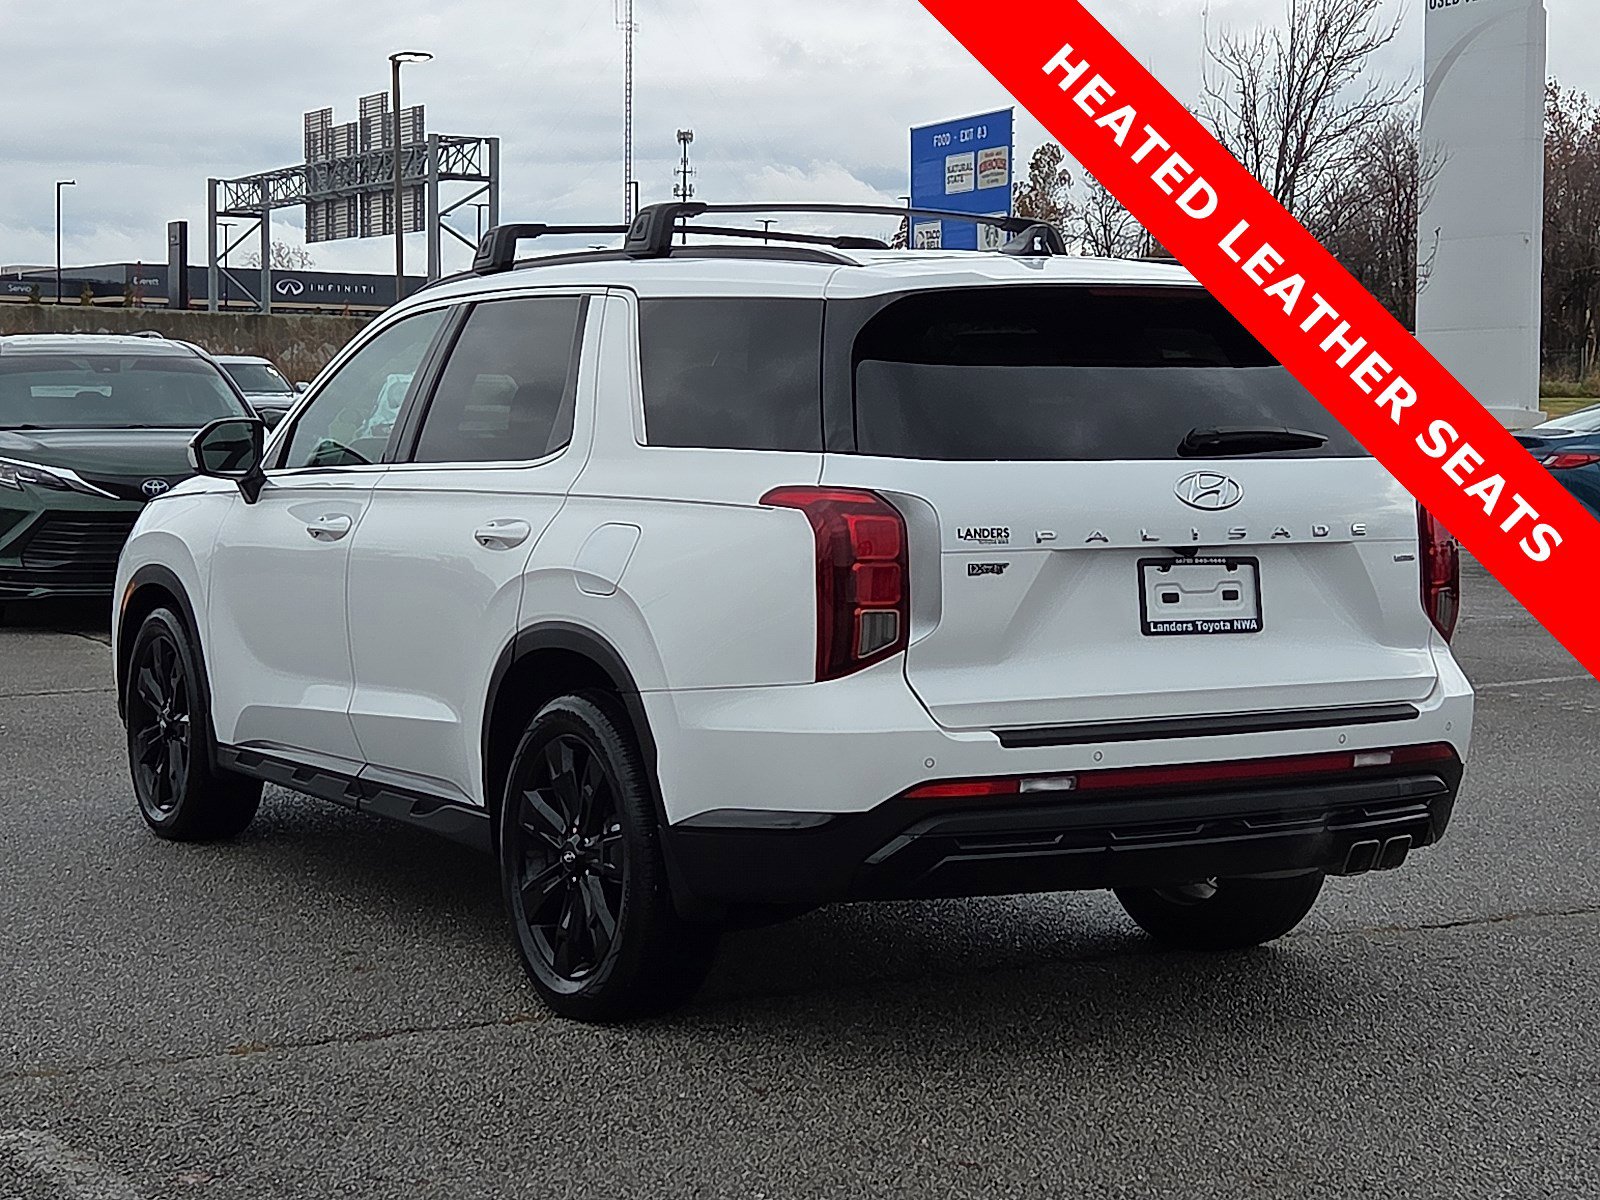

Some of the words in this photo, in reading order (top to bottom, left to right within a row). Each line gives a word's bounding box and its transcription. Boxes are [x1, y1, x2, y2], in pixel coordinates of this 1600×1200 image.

[933, 132, 951, 147] FOOD
[960, 128, 974, 143] EXIT
[946, 162, 974, 174] NATURAL
[946, 174, 965, 185] STATE
[925, 229, 941, 240] TACO
[310, 283, 375, 294] INFINITI
[957, 527, 1010, 540] LANDERS
[1035, 522, 1368, 543] PALISADE
[1150, 621, 1194, 632] Landers
[1195, 620, 1231, 633] Toyota
[1233, 619, 1258, 630] NWA
